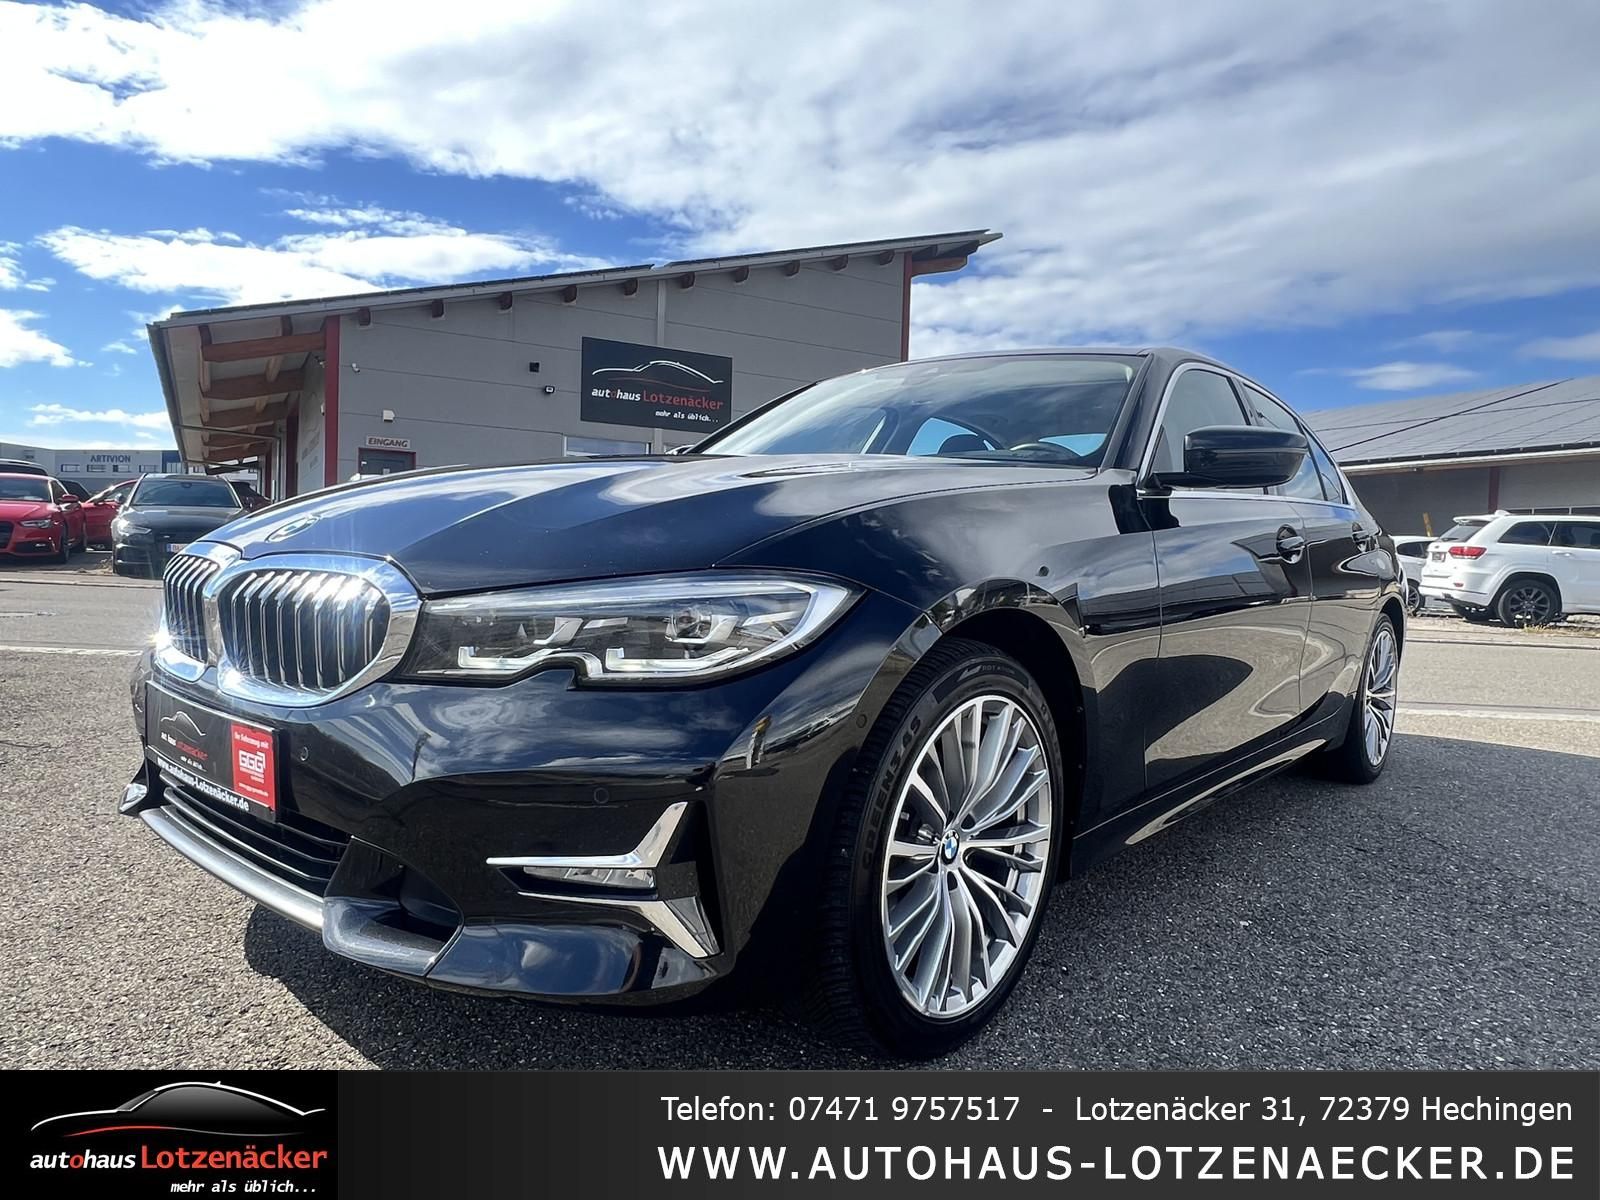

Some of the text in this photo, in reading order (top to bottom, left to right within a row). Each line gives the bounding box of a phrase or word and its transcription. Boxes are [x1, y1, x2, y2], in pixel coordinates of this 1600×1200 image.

[591, 388, 723, 410] autohaus Lotzenäcker
[368, 437, 409, 448] EINGANG
[90, 454, 131, 463] ARTIVION
